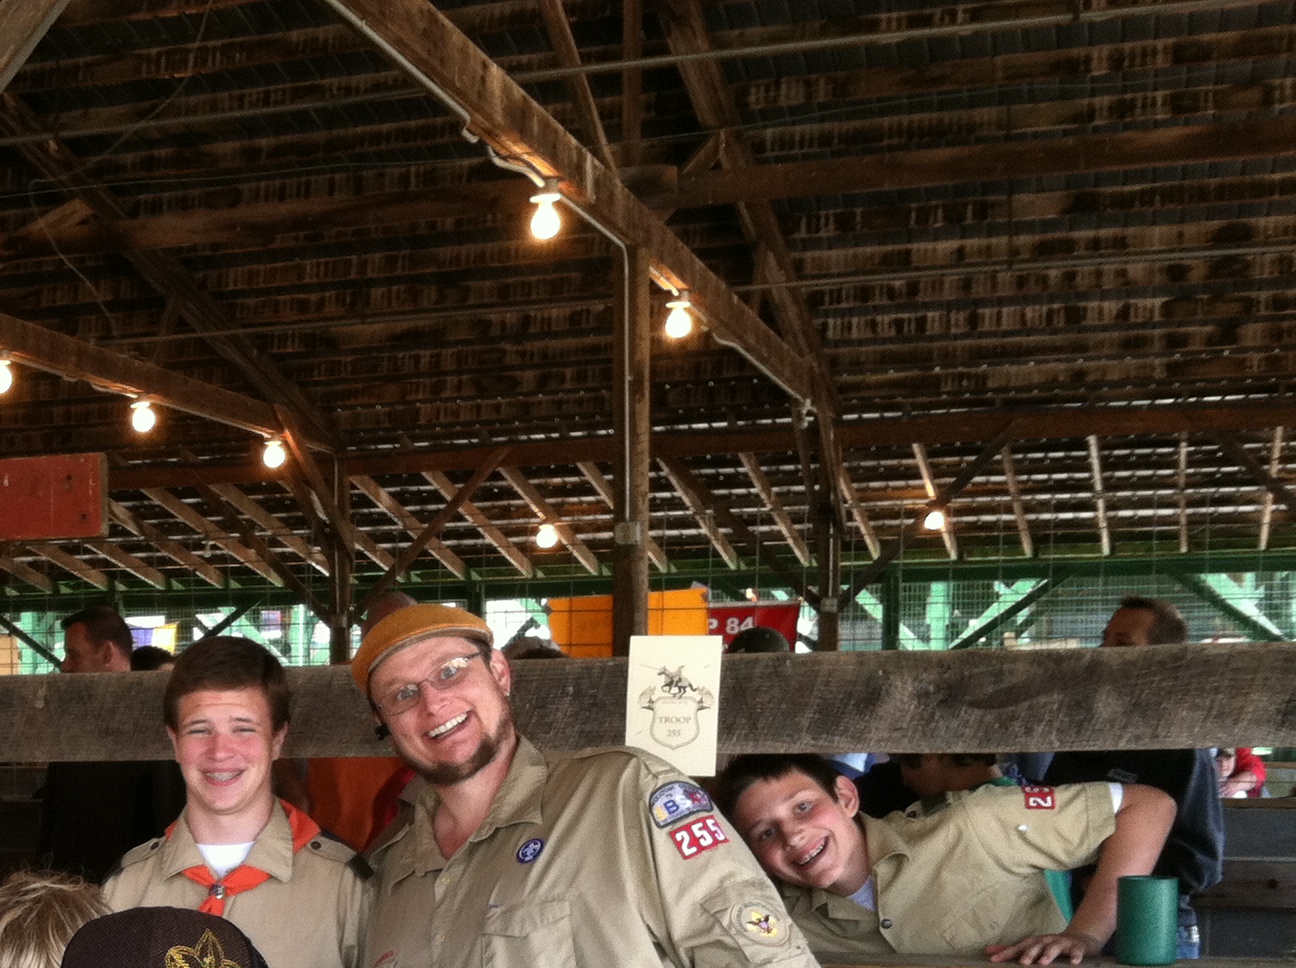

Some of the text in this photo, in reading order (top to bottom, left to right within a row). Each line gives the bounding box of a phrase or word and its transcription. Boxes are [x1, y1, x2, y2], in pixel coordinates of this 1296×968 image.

[658, 716, 692, 724] TROOP
[666, 729, 682, 737] 255
[675, 818, 726, 856] 255
